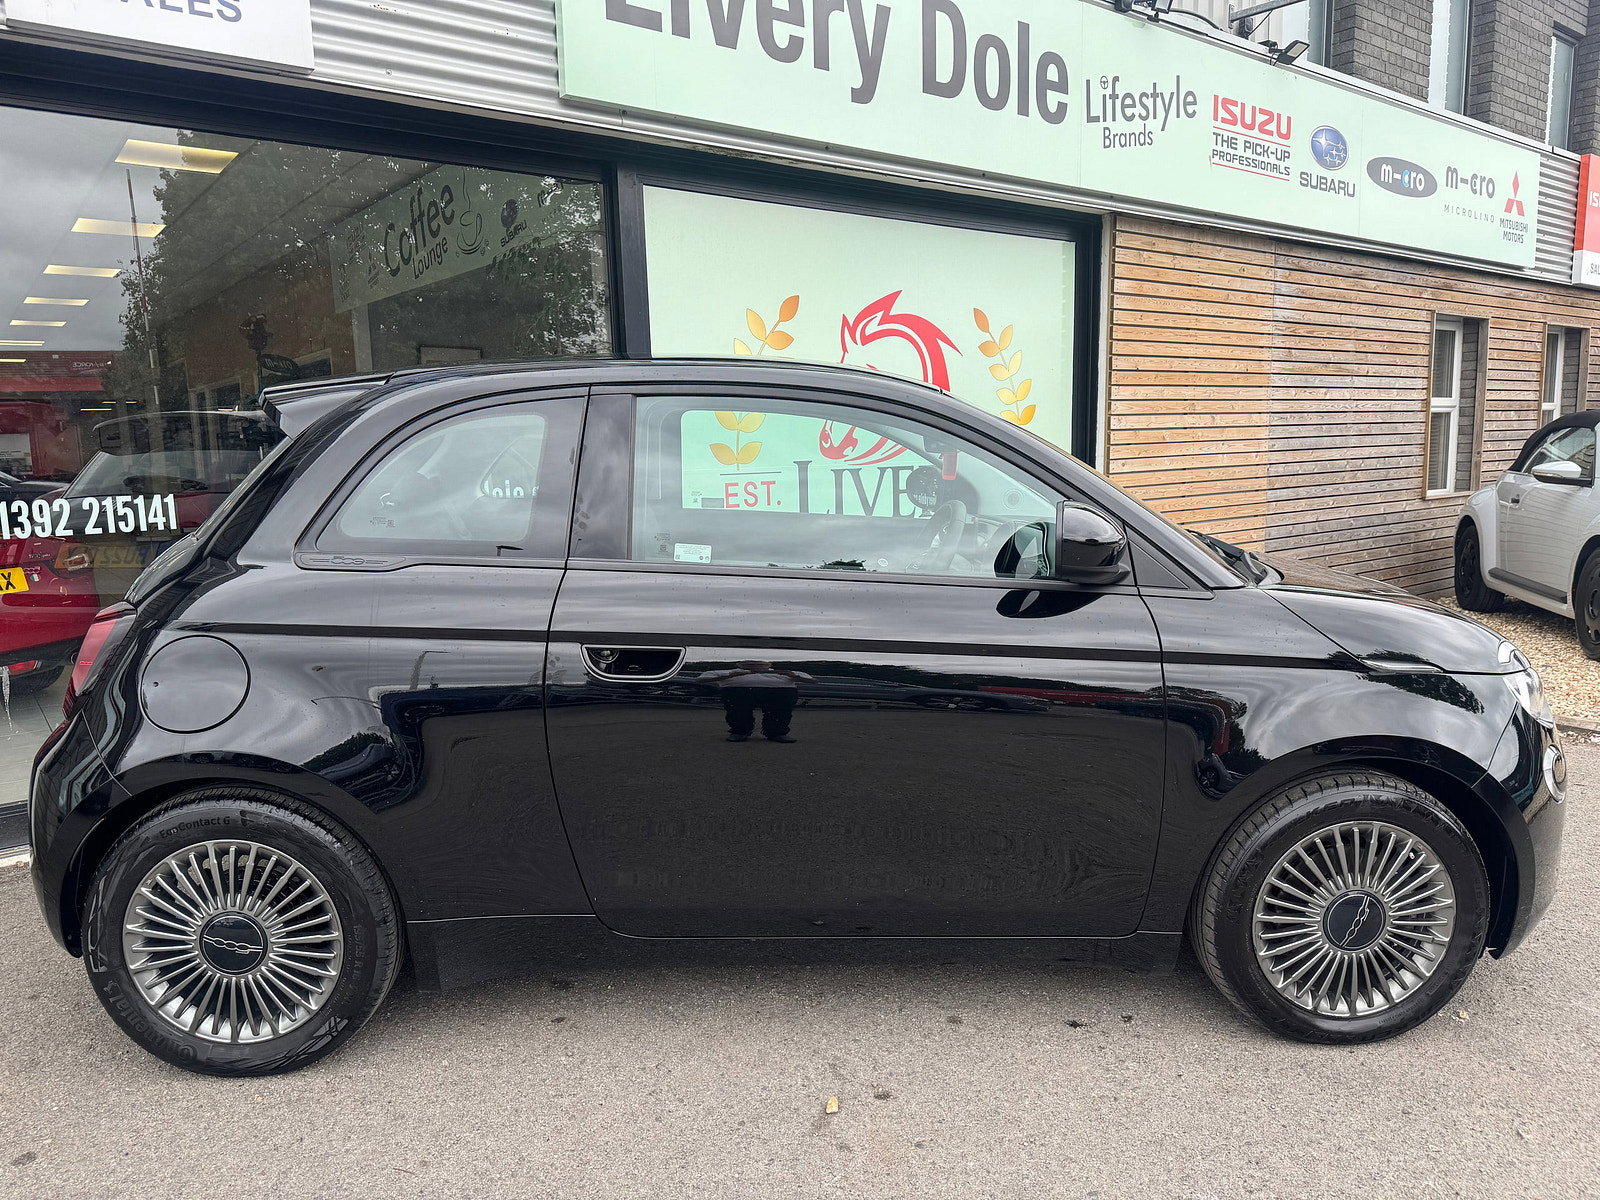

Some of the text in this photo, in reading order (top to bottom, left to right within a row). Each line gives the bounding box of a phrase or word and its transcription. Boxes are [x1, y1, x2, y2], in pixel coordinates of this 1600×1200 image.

[606, 0, 1069, 125] very Dole
[1086, 75, 1198, 131] Lifestyle
[1213, 94, 1292, 141] ISUZU
[1103, 123, 1153, 149] Brands
[1212, 131, 1291, 163] THE PICK-UP
[1212, 148, 1291, 176] PROFESSIONALS
[1299, 171, 1356, 198] SUBARU
[1589, 190, 1600, 208] IS
[1444, 203, 1495, 224] MICROLINO
[1499, 217, 1529, 233] MITSUBISHI
[384, 184, 455, 278] Coffee
[1502, 230, 1524, 244] MOTORS
[413, 236, 449, 280] Lounge
[724, 480, 782, 509] EST.
[793, 460, 937, 518] LIVE
[0, 493, 178, 540] 1392 215141
